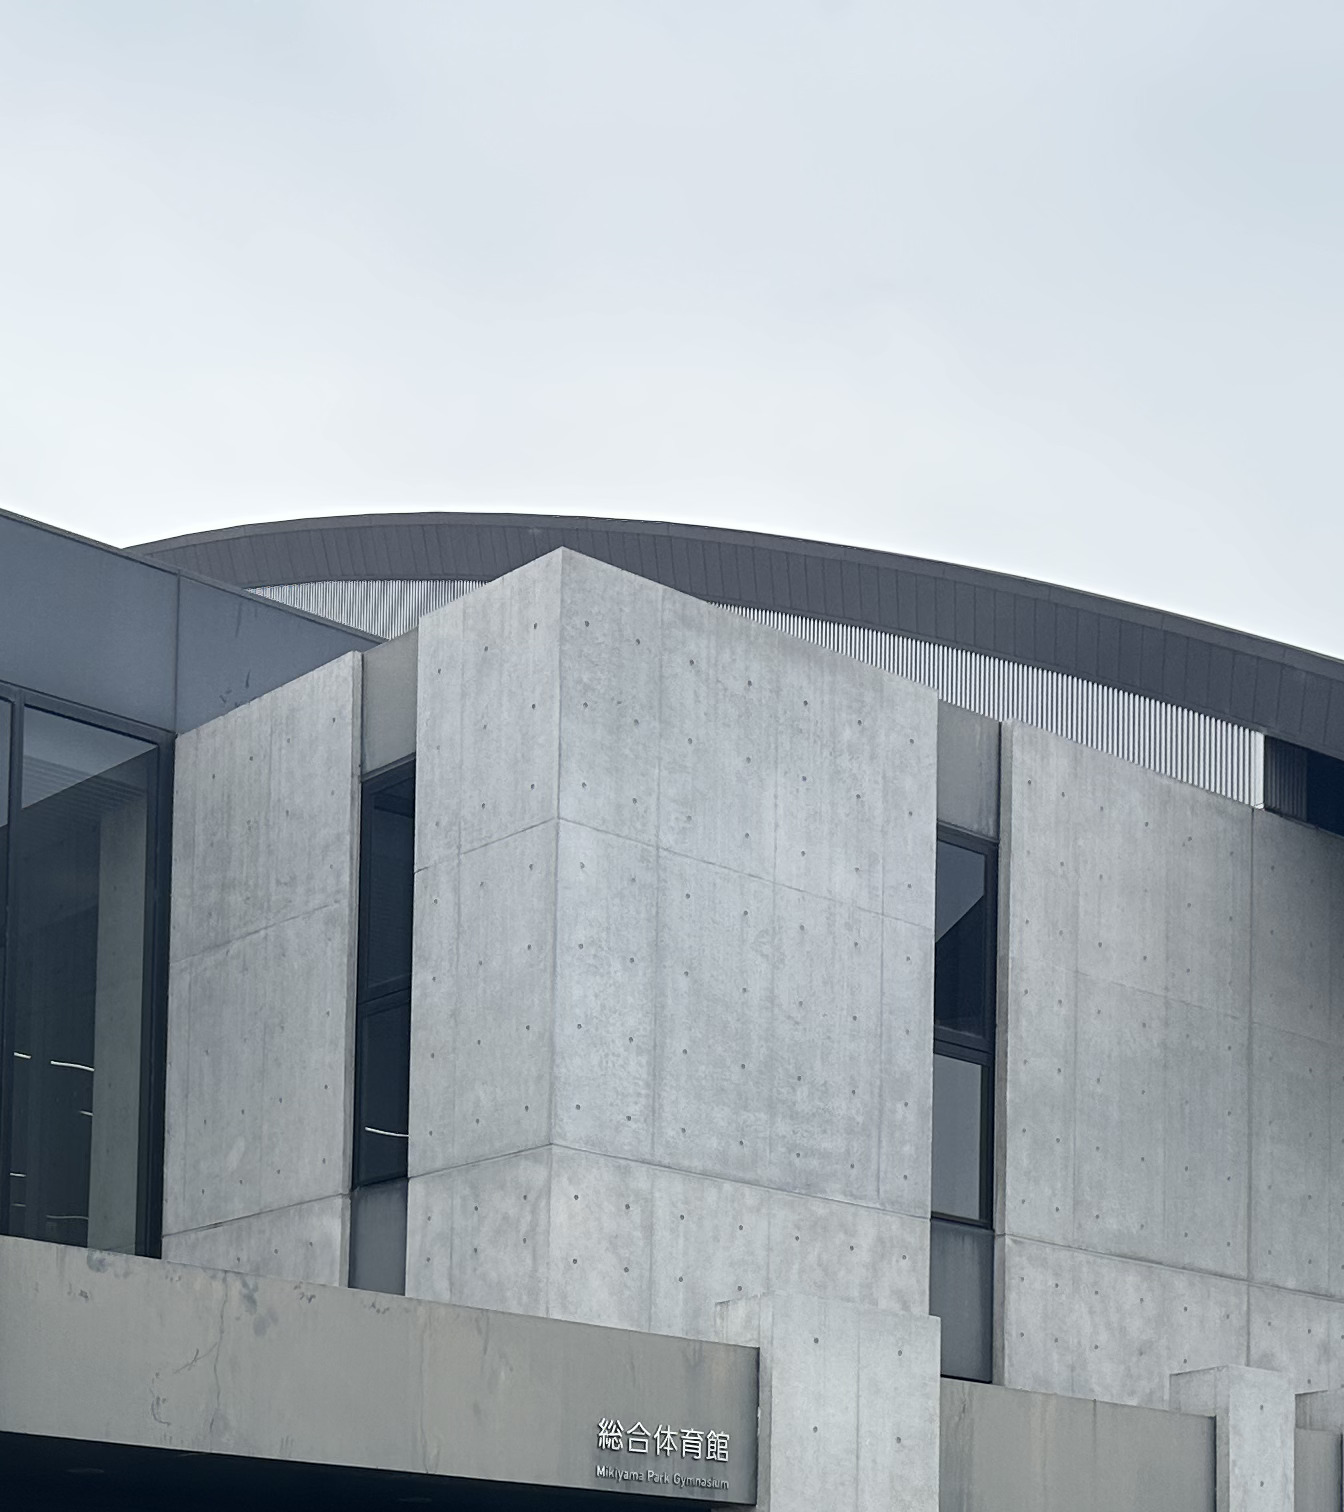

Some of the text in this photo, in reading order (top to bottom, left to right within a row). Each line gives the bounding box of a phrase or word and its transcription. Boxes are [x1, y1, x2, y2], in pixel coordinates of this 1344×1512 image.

[598, 1417, 730, 1462] 総合体育館
[596, 1465, 729, 1490] Mikiyama Park Gymnasium
